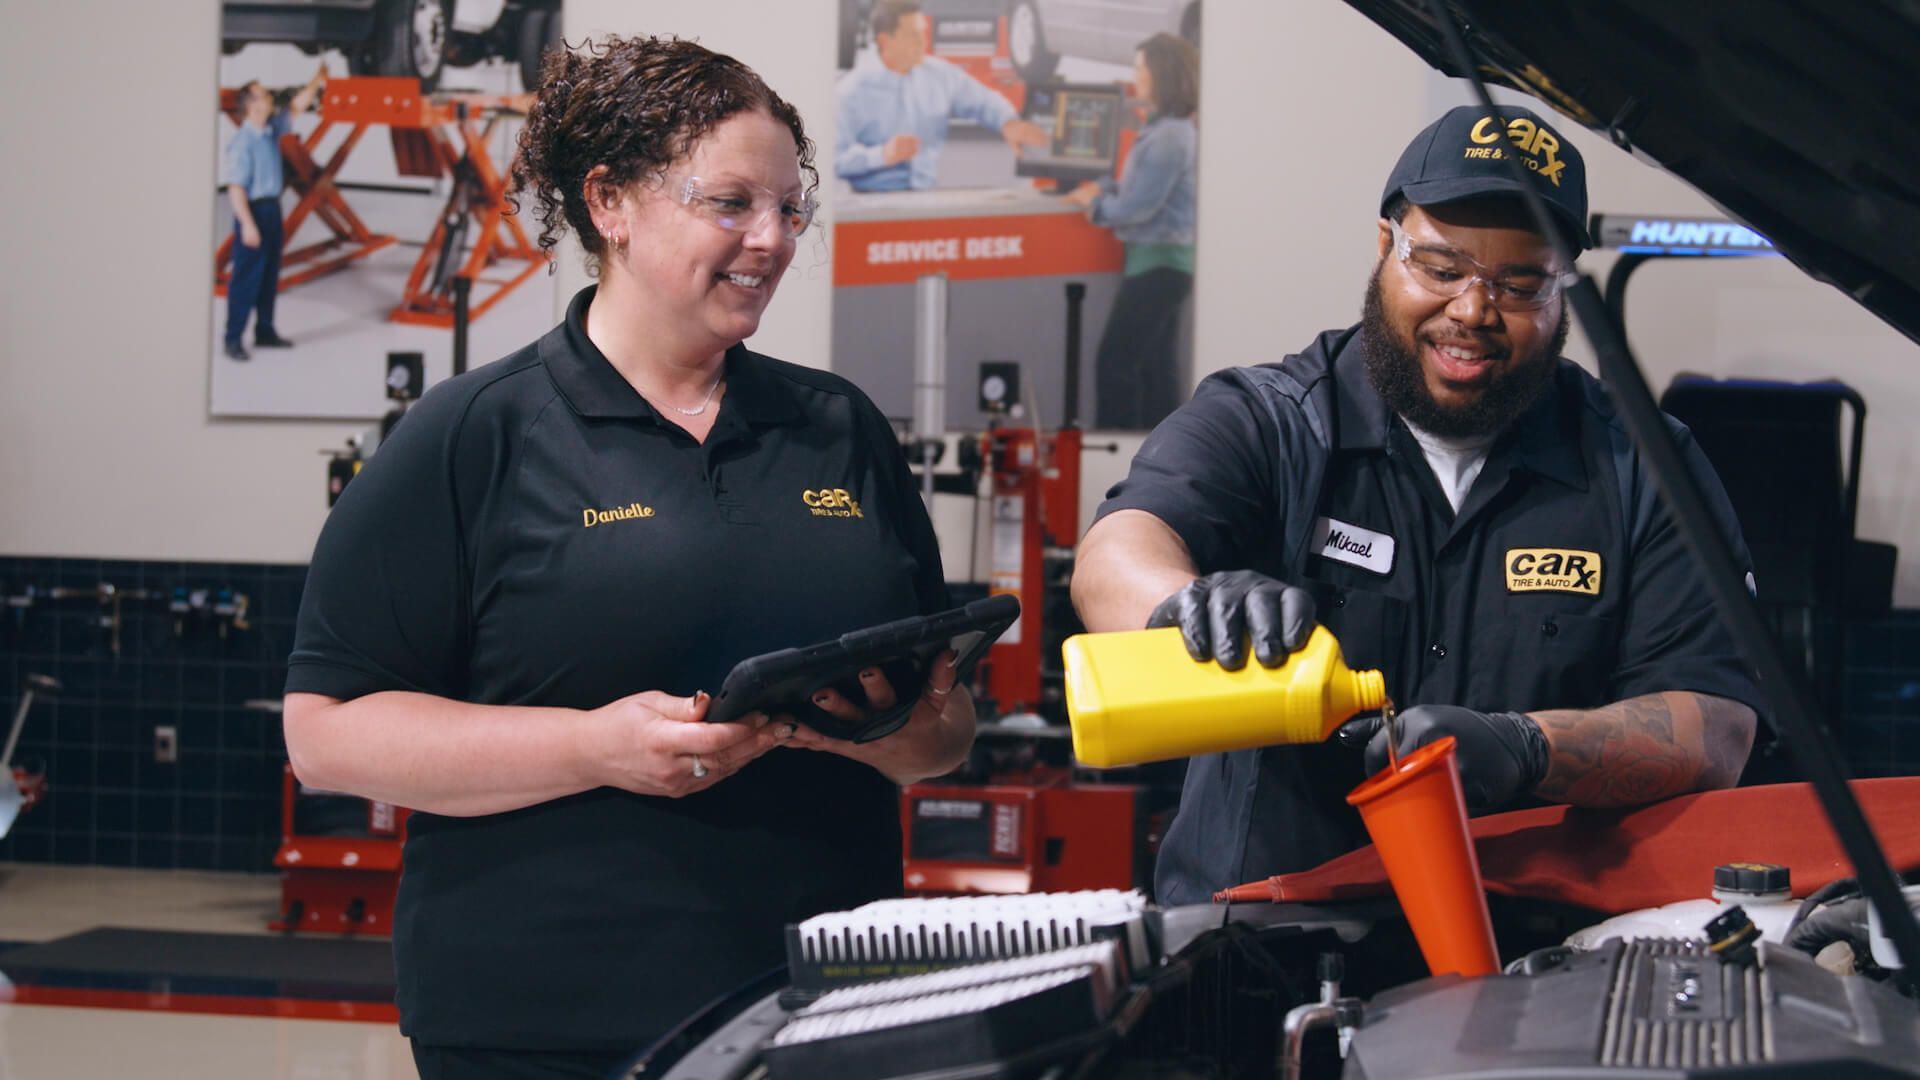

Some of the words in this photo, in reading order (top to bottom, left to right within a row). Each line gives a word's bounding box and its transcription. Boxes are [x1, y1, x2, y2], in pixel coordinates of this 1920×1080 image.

[1464, 148, 1493, 159] TIRE
[1492, 149, 1503, 160] &
[867, 239, 960, 264] SERVICE
[965, 235, 1024, 260] DESK
[583, 503, 655, 528] Danielle
[1325, 529, 1373, 558] Mikael
[1512, 578, 1534, 588] TIRE
[1535, 578, 1542, 587] &
[1544, 578, 1571, 588] AUTO
